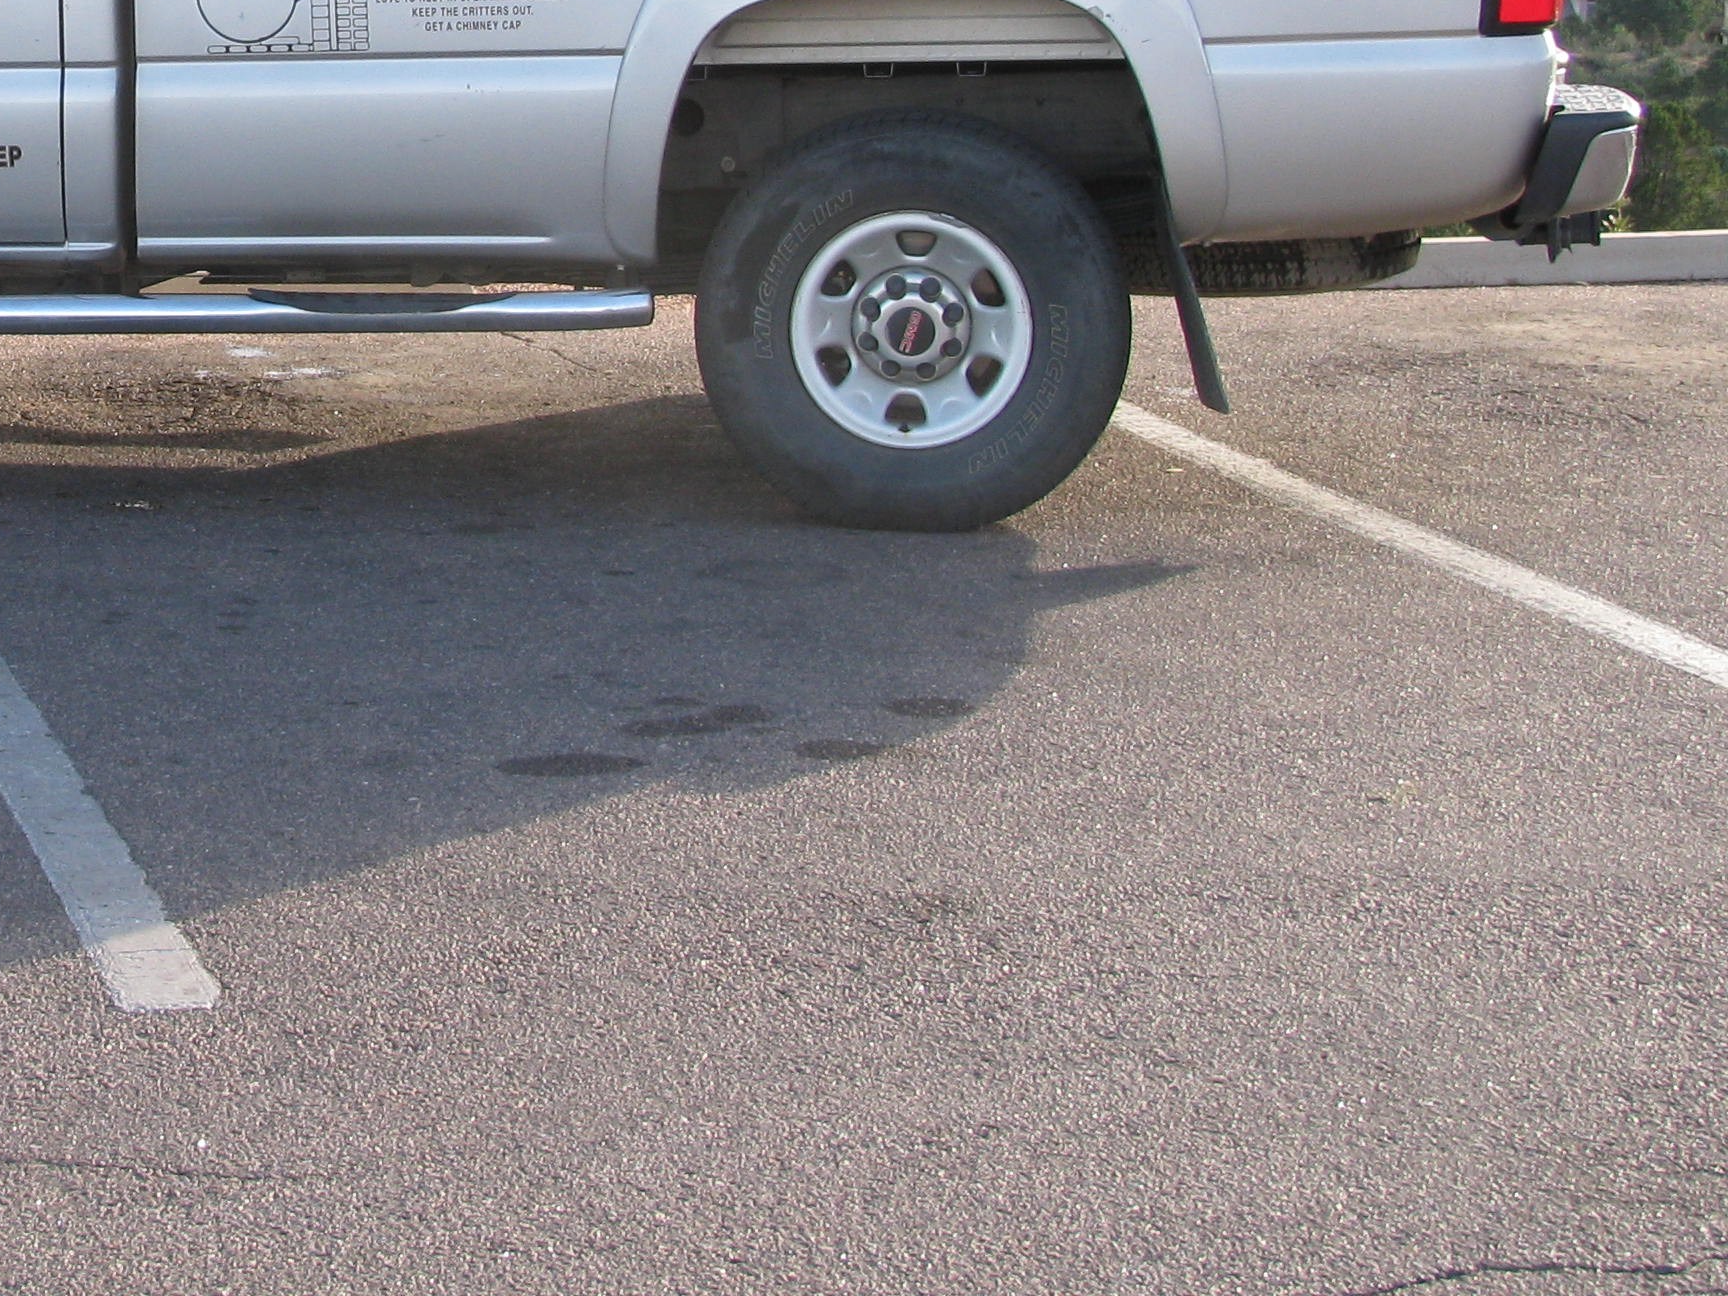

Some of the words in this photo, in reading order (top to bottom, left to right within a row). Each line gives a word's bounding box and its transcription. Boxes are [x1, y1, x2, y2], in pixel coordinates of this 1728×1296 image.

[412, 7, 437, 17] KEEP
[441, 6, 459, 17] THE
[462, 5, 509, 16] CRITTERS
[425, 21, 445, 32] GET
[446, 21, 453, 31] A
[455, 20, 498, 31] CHIMNEY
[502, 20, 522, 31] CAP
[753, 188, 855, 360] MICHELIN
